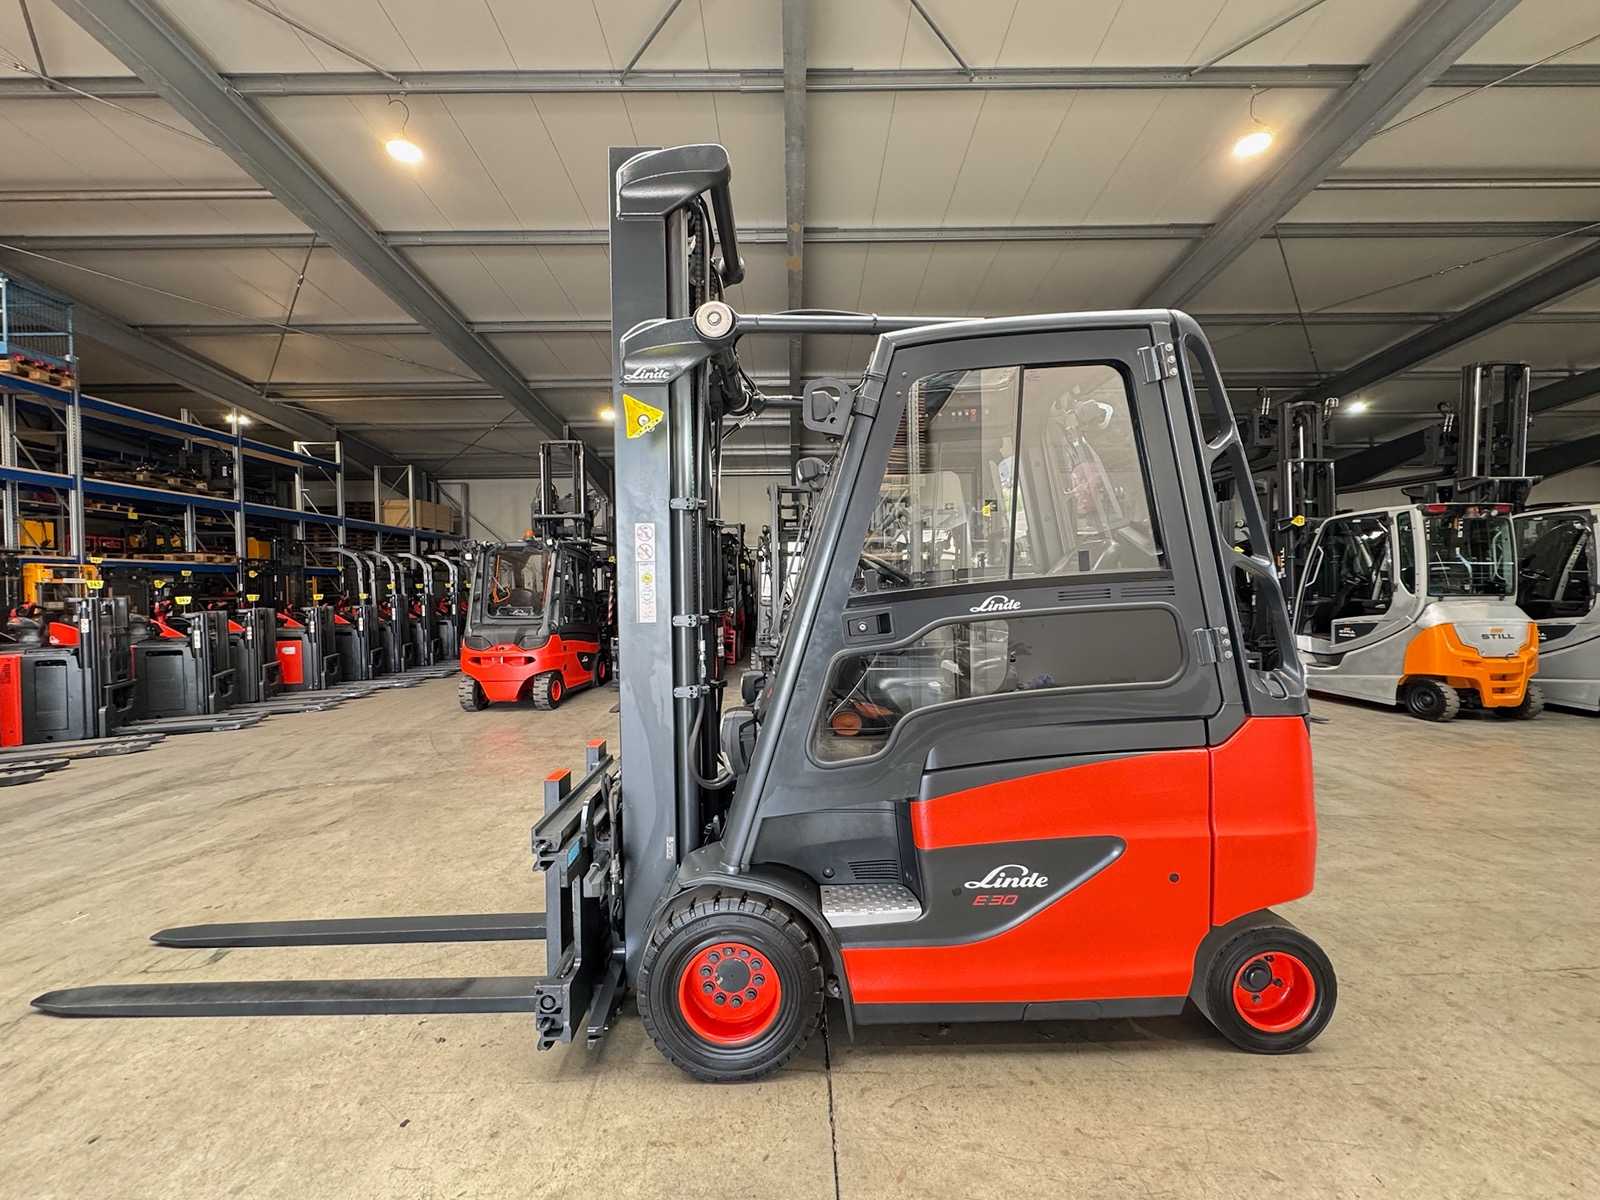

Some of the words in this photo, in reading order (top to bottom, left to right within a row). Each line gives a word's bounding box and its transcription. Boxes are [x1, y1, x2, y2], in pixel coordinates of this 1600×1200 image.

[624, 365, 670, 380] Linde
[969, 595, 1022, 612] Linde
[964, 864, 1049, 889] Linde
